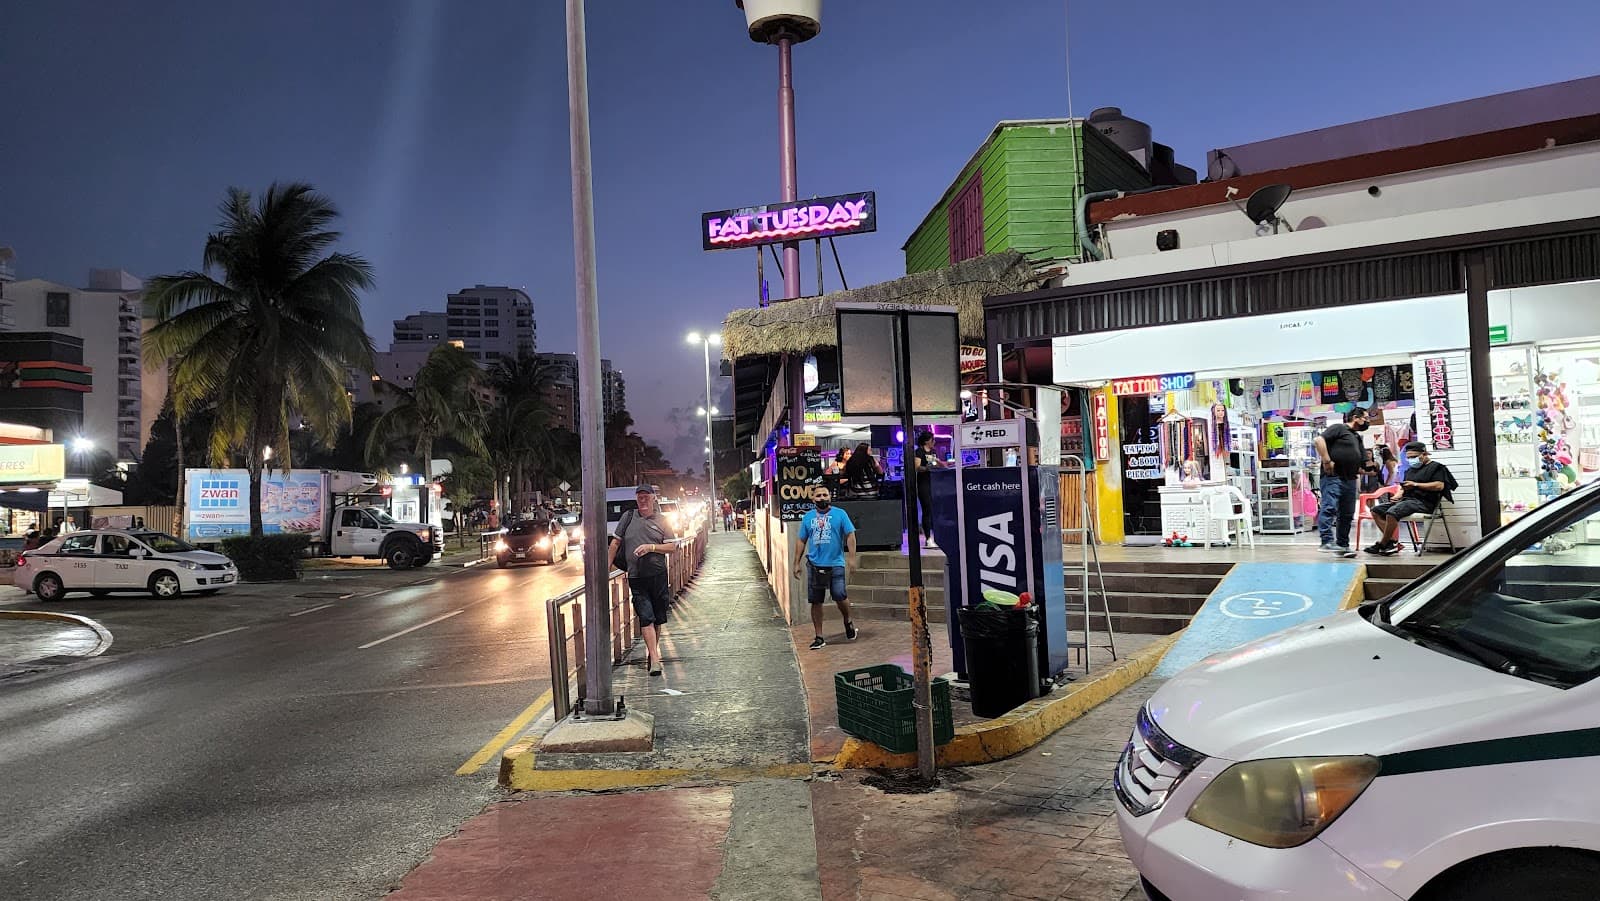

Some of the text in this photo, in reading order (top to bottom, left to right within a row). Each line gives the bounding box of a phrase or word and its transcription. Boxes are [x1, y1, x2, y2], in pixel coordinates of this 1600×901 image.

[708, 215, 753, 238] FAT
[758, 199, 866, 232] TUESDAY
[961, 346, 972, 356] TO
[1113, 373, 1193, 396] TATTOO SHOP
[1095, 394, 1108, 459] TATTOO
[985, 429, 1007, 438] RED
[1129, 455, 1160, 467] & BODY
[782, 465, 808, 480] NO
[780, 484, 818, 500] COVE
[967, 482, 1021, 491] Get cash here
[201, 489, 238, 498] zwan
[783, 503, 794, 511] FAT
[977, 511, 1017, 592] ISA
